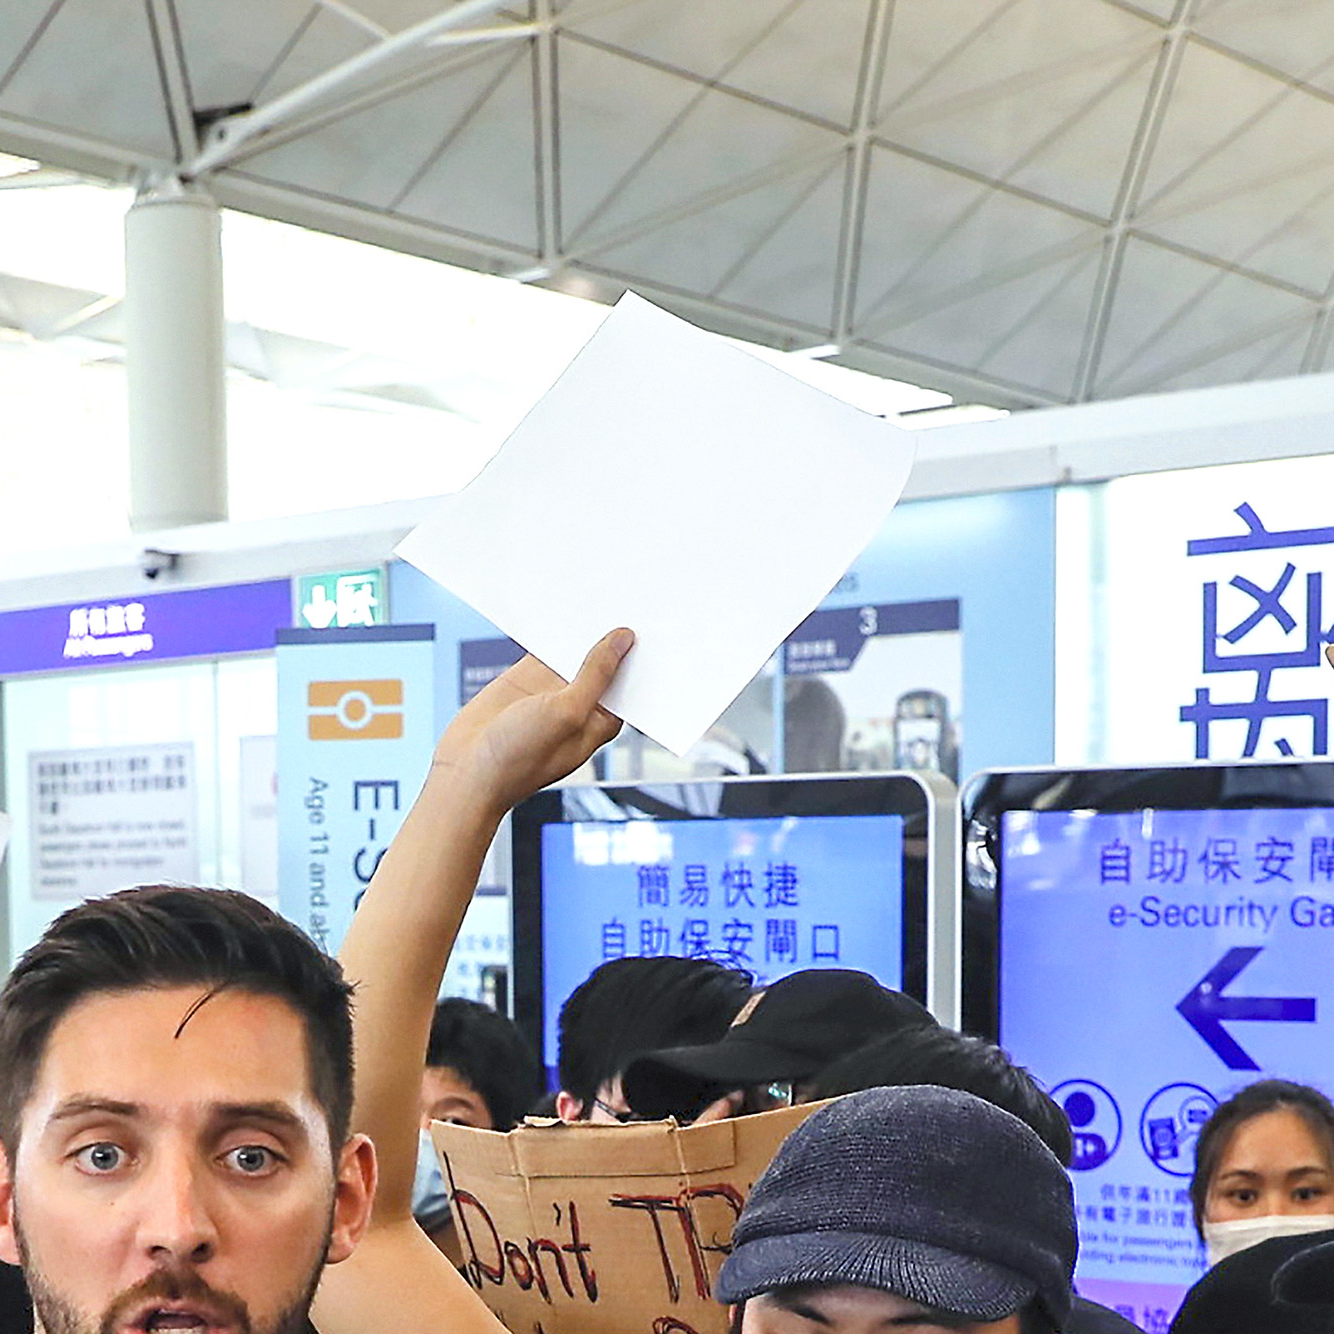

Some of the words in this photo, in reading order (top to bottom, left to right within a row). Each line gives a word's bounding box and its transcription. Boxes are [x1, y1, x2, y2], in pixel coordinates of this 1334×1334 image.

[859, 606, 878, 635] 3
[305, 777, 329, 825] Age
[310, 832, 330, 855] 11
[353, 780, 399, 912] E-S
[310, 863, 330, 907] and
[637, 862, 799, 908] 簡易快捷
[1109, 896, 1278, 933] e-Security
[602, 917, 839, 963] 自助保安閘口
[443, 1150, 598, 1304] Don't
